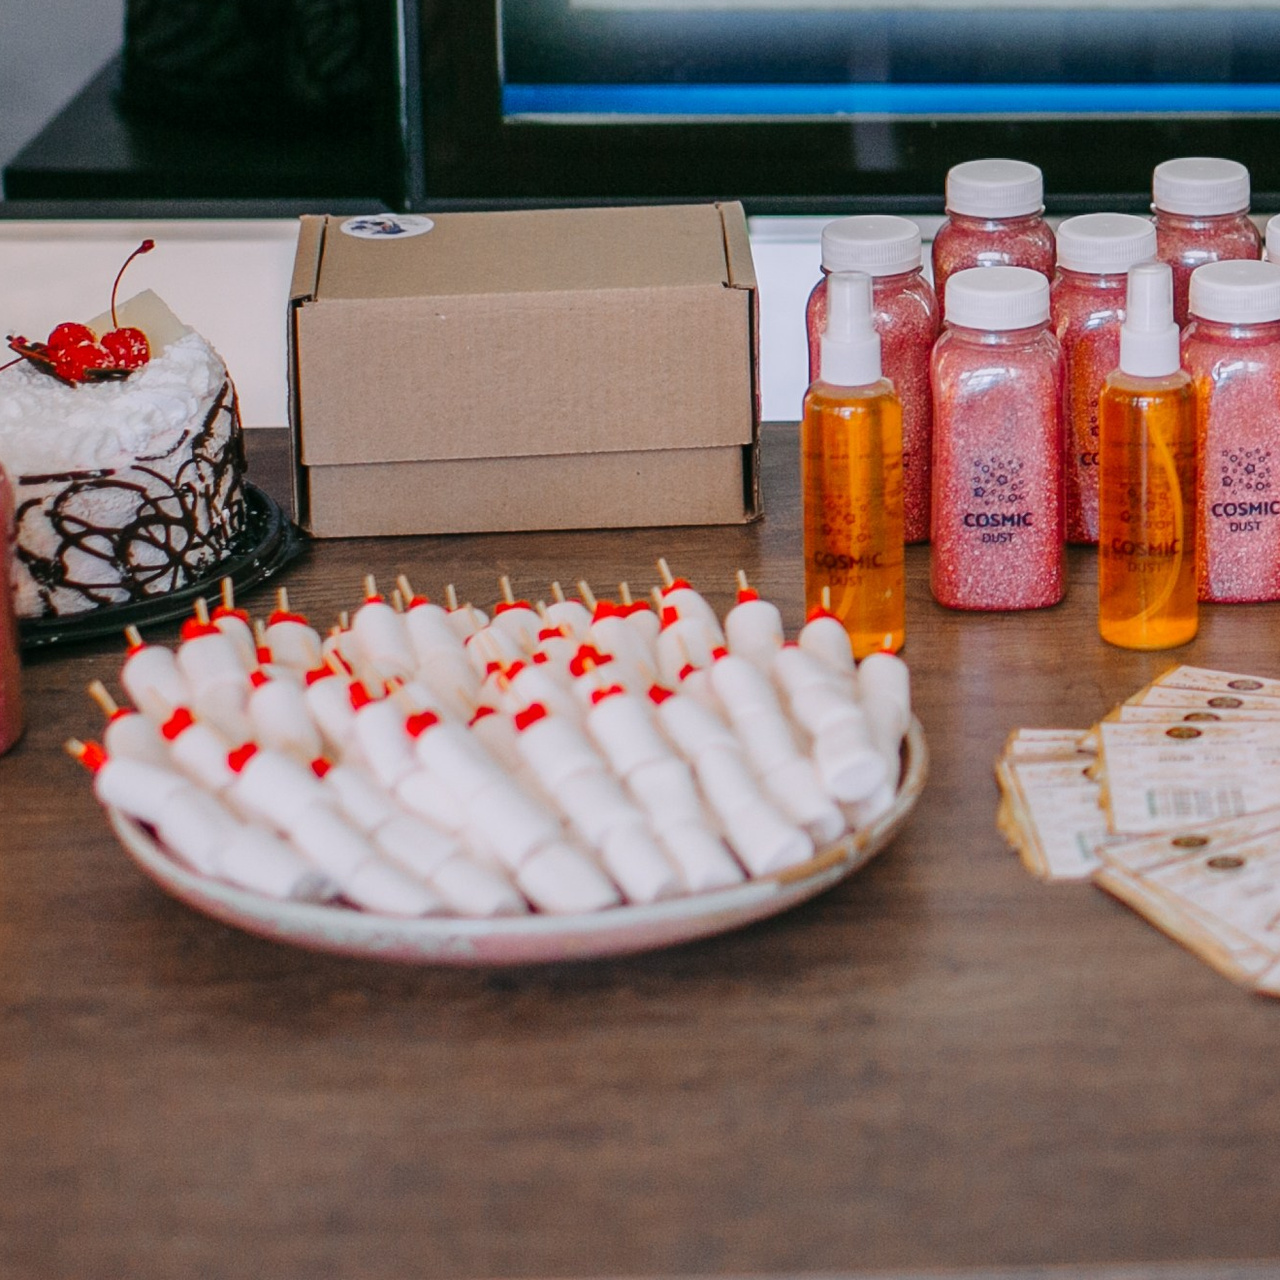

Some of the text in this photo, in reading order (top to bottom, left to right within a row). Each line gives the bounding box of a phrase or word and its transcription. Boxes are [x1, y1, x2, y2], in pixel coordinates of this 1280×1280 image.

[1211, 500, 1280, 518] COSMIC
[963, 512, 1033, 528] COSMIC
[1229, 521, 1262, 533] DUST
[981, 532, 1015, 544] DUST
[1112, 537, 1181, 557] COSMIC
[814, 551, 884, 570] COSMIC
